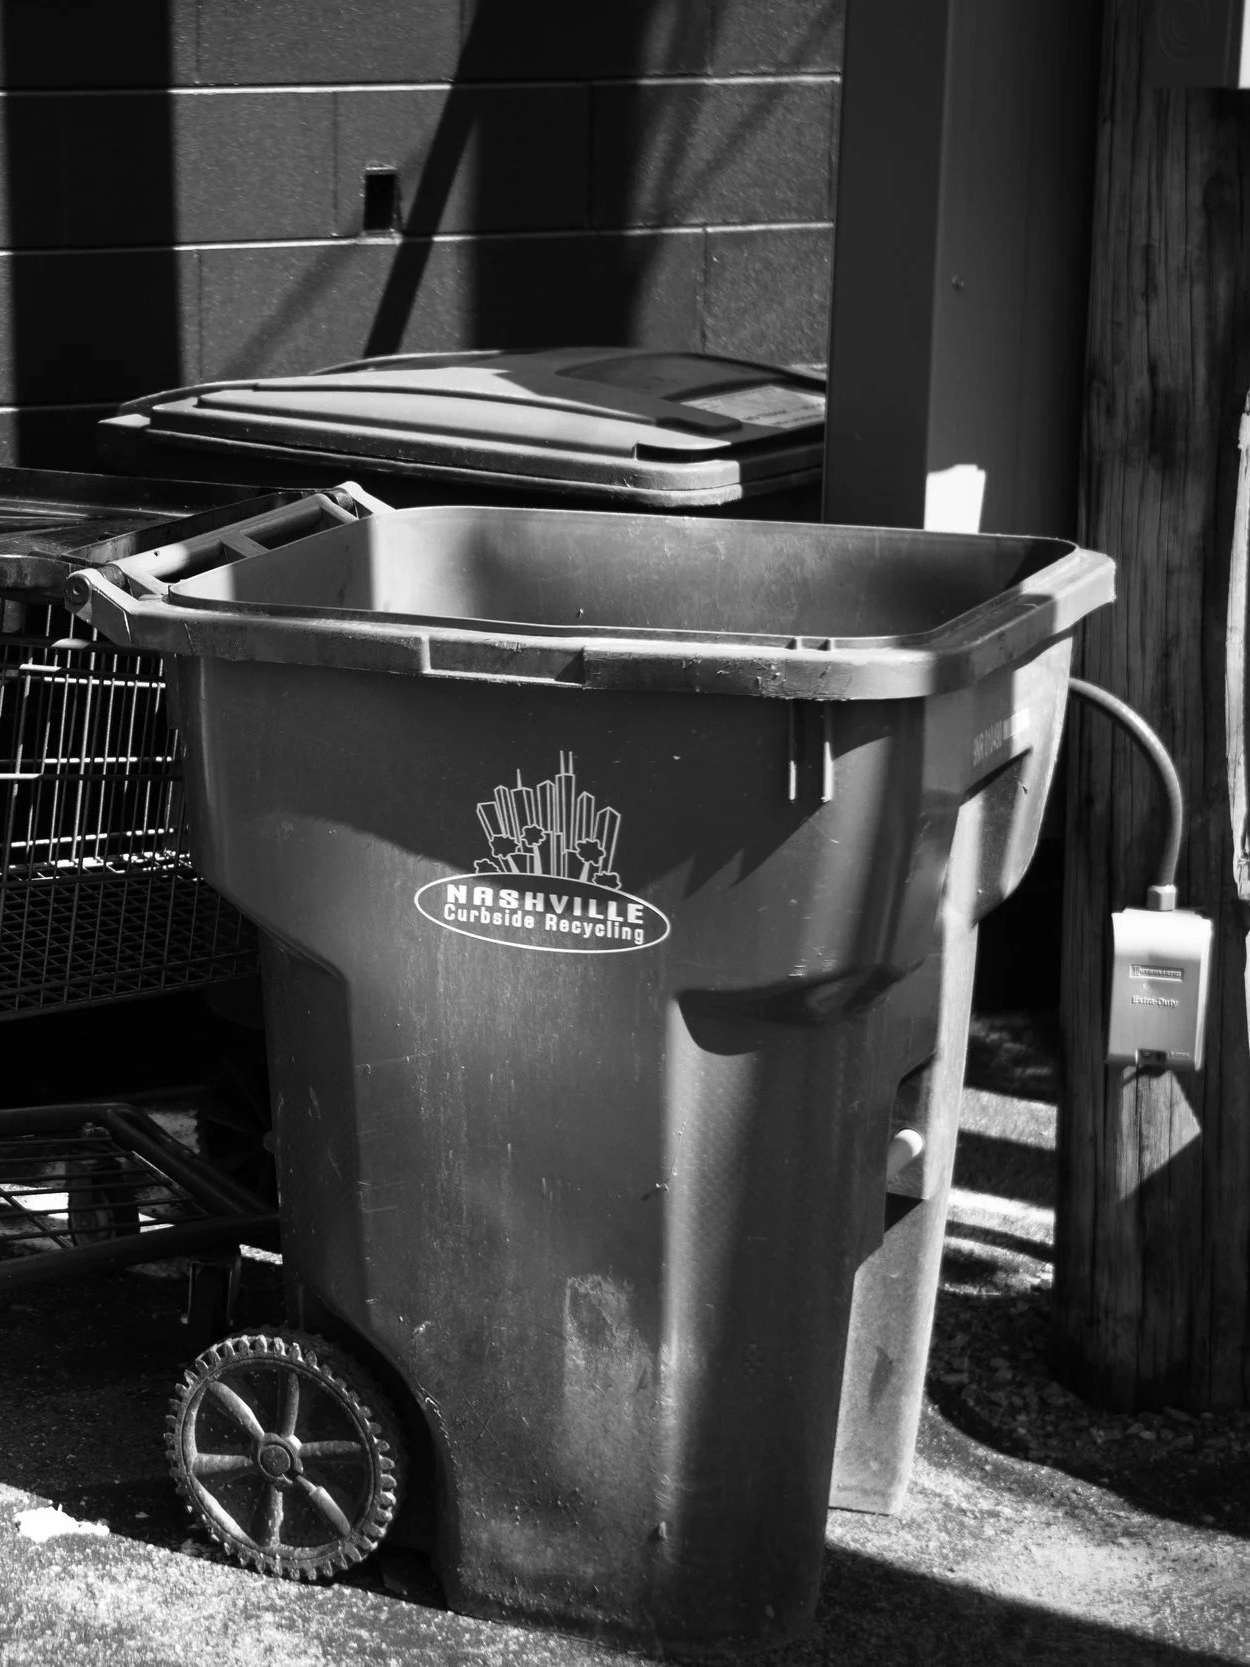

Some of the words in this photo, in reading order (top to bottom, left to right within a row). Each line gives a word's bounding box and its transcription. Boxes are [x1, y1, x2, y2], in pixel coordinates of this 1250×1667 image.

[443, 903, 535, 929] Curbside
[545, 913, 644, 945] Recycling
[446, 884, 644, 924] NASHVILLE
